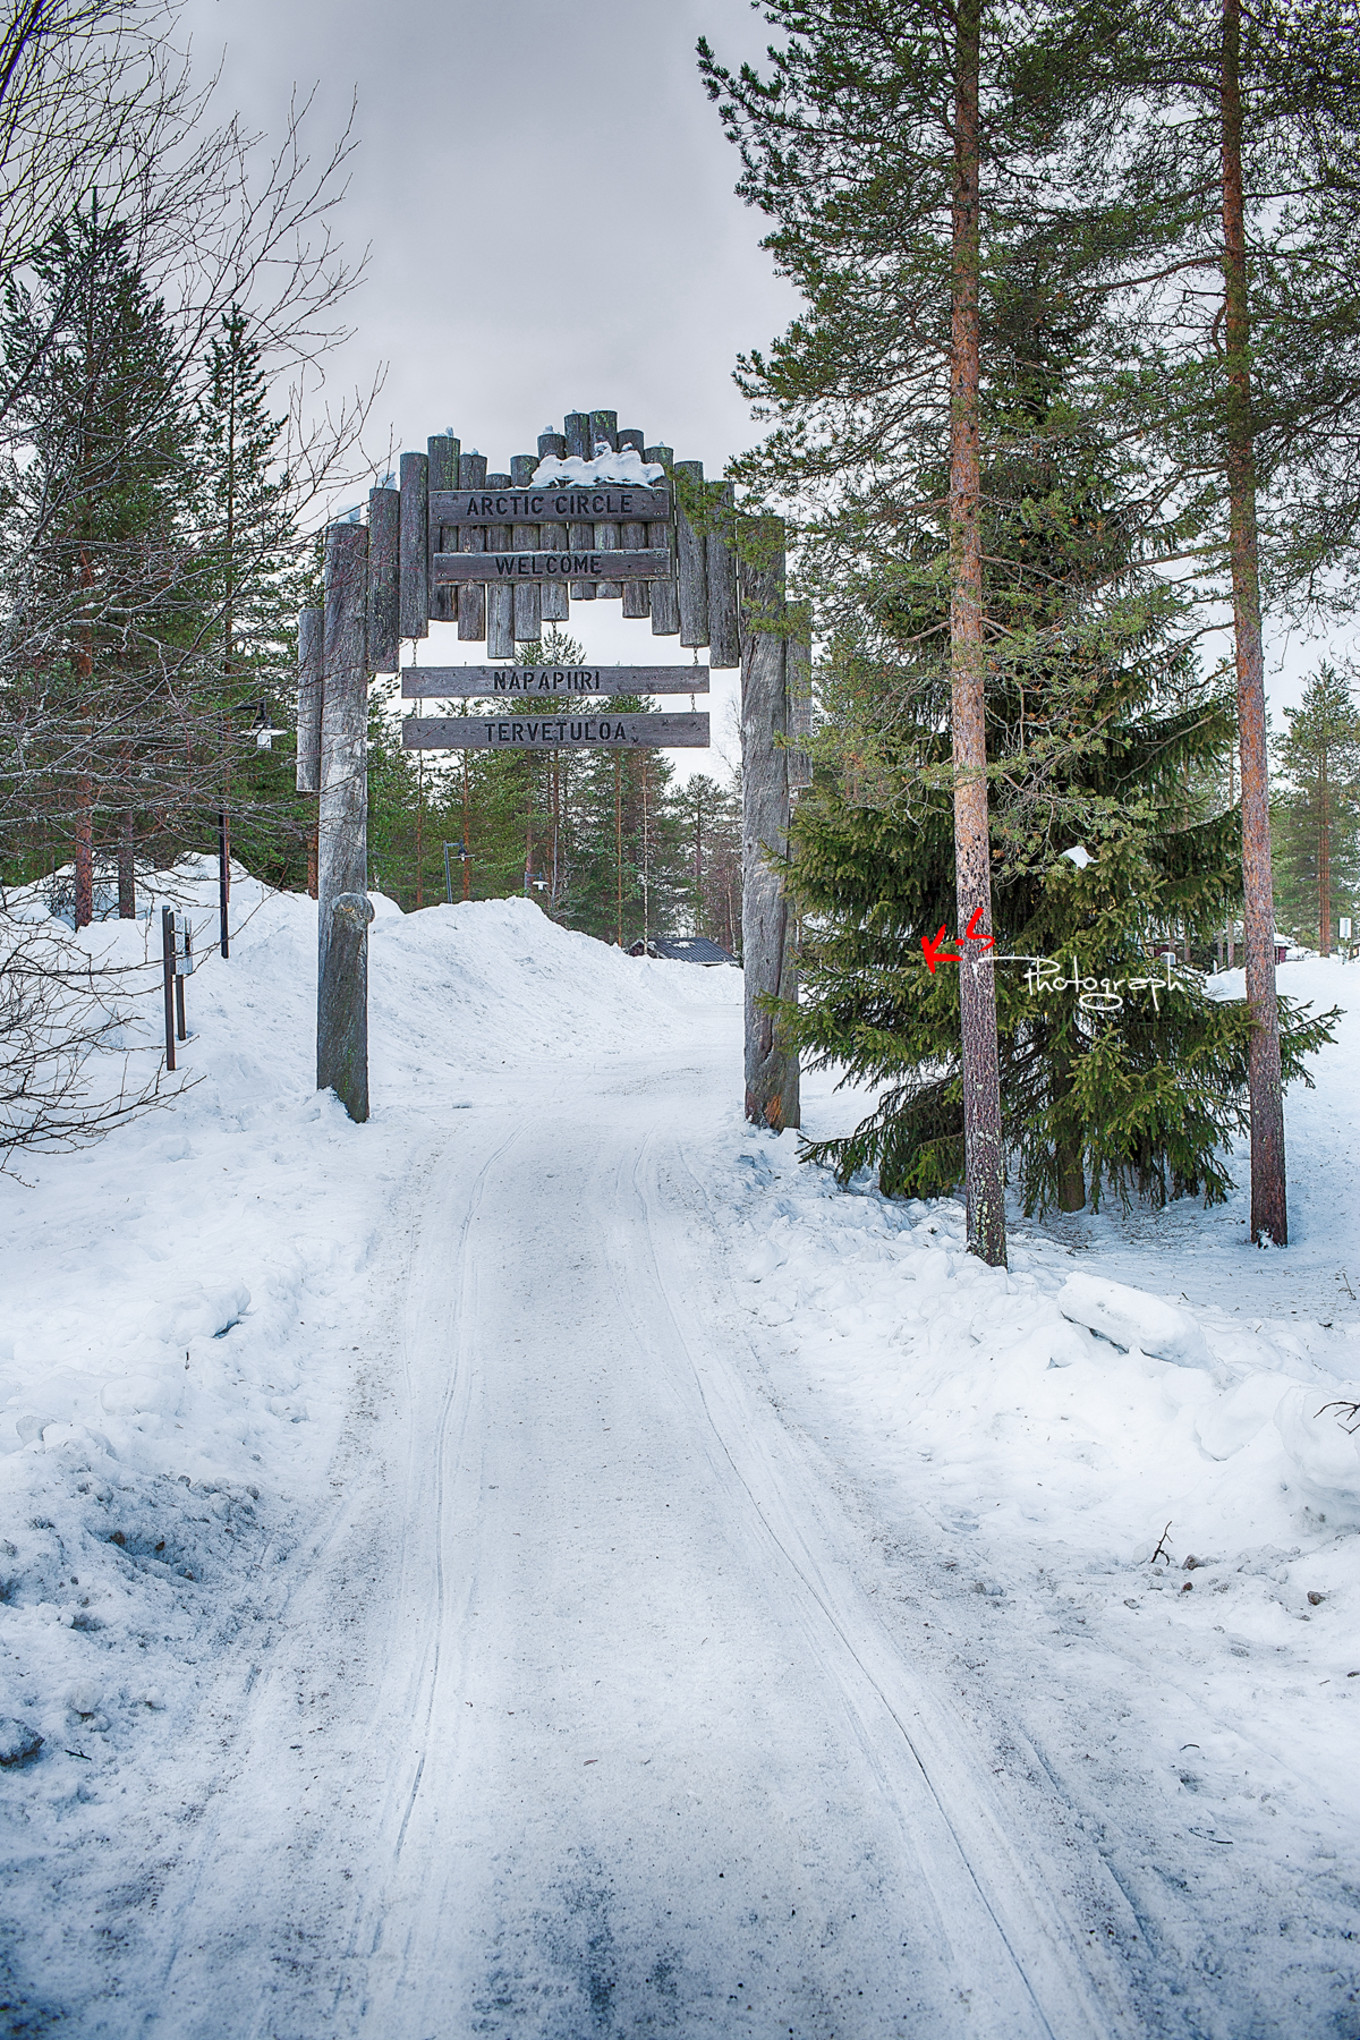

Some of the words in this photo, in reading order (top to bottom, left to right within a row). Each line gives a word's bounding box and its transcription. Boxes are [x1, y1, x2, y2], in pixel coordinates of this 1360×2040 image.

[466, 494, 544, 516] ARCTIC
[555, 493, 633, 514] CIRCLE
[495, 555, 603, 576] WELCOME
[493, 670, 600, 690] NAPAPIIRI
[484, 721, 627, 742] TERVETULOA
